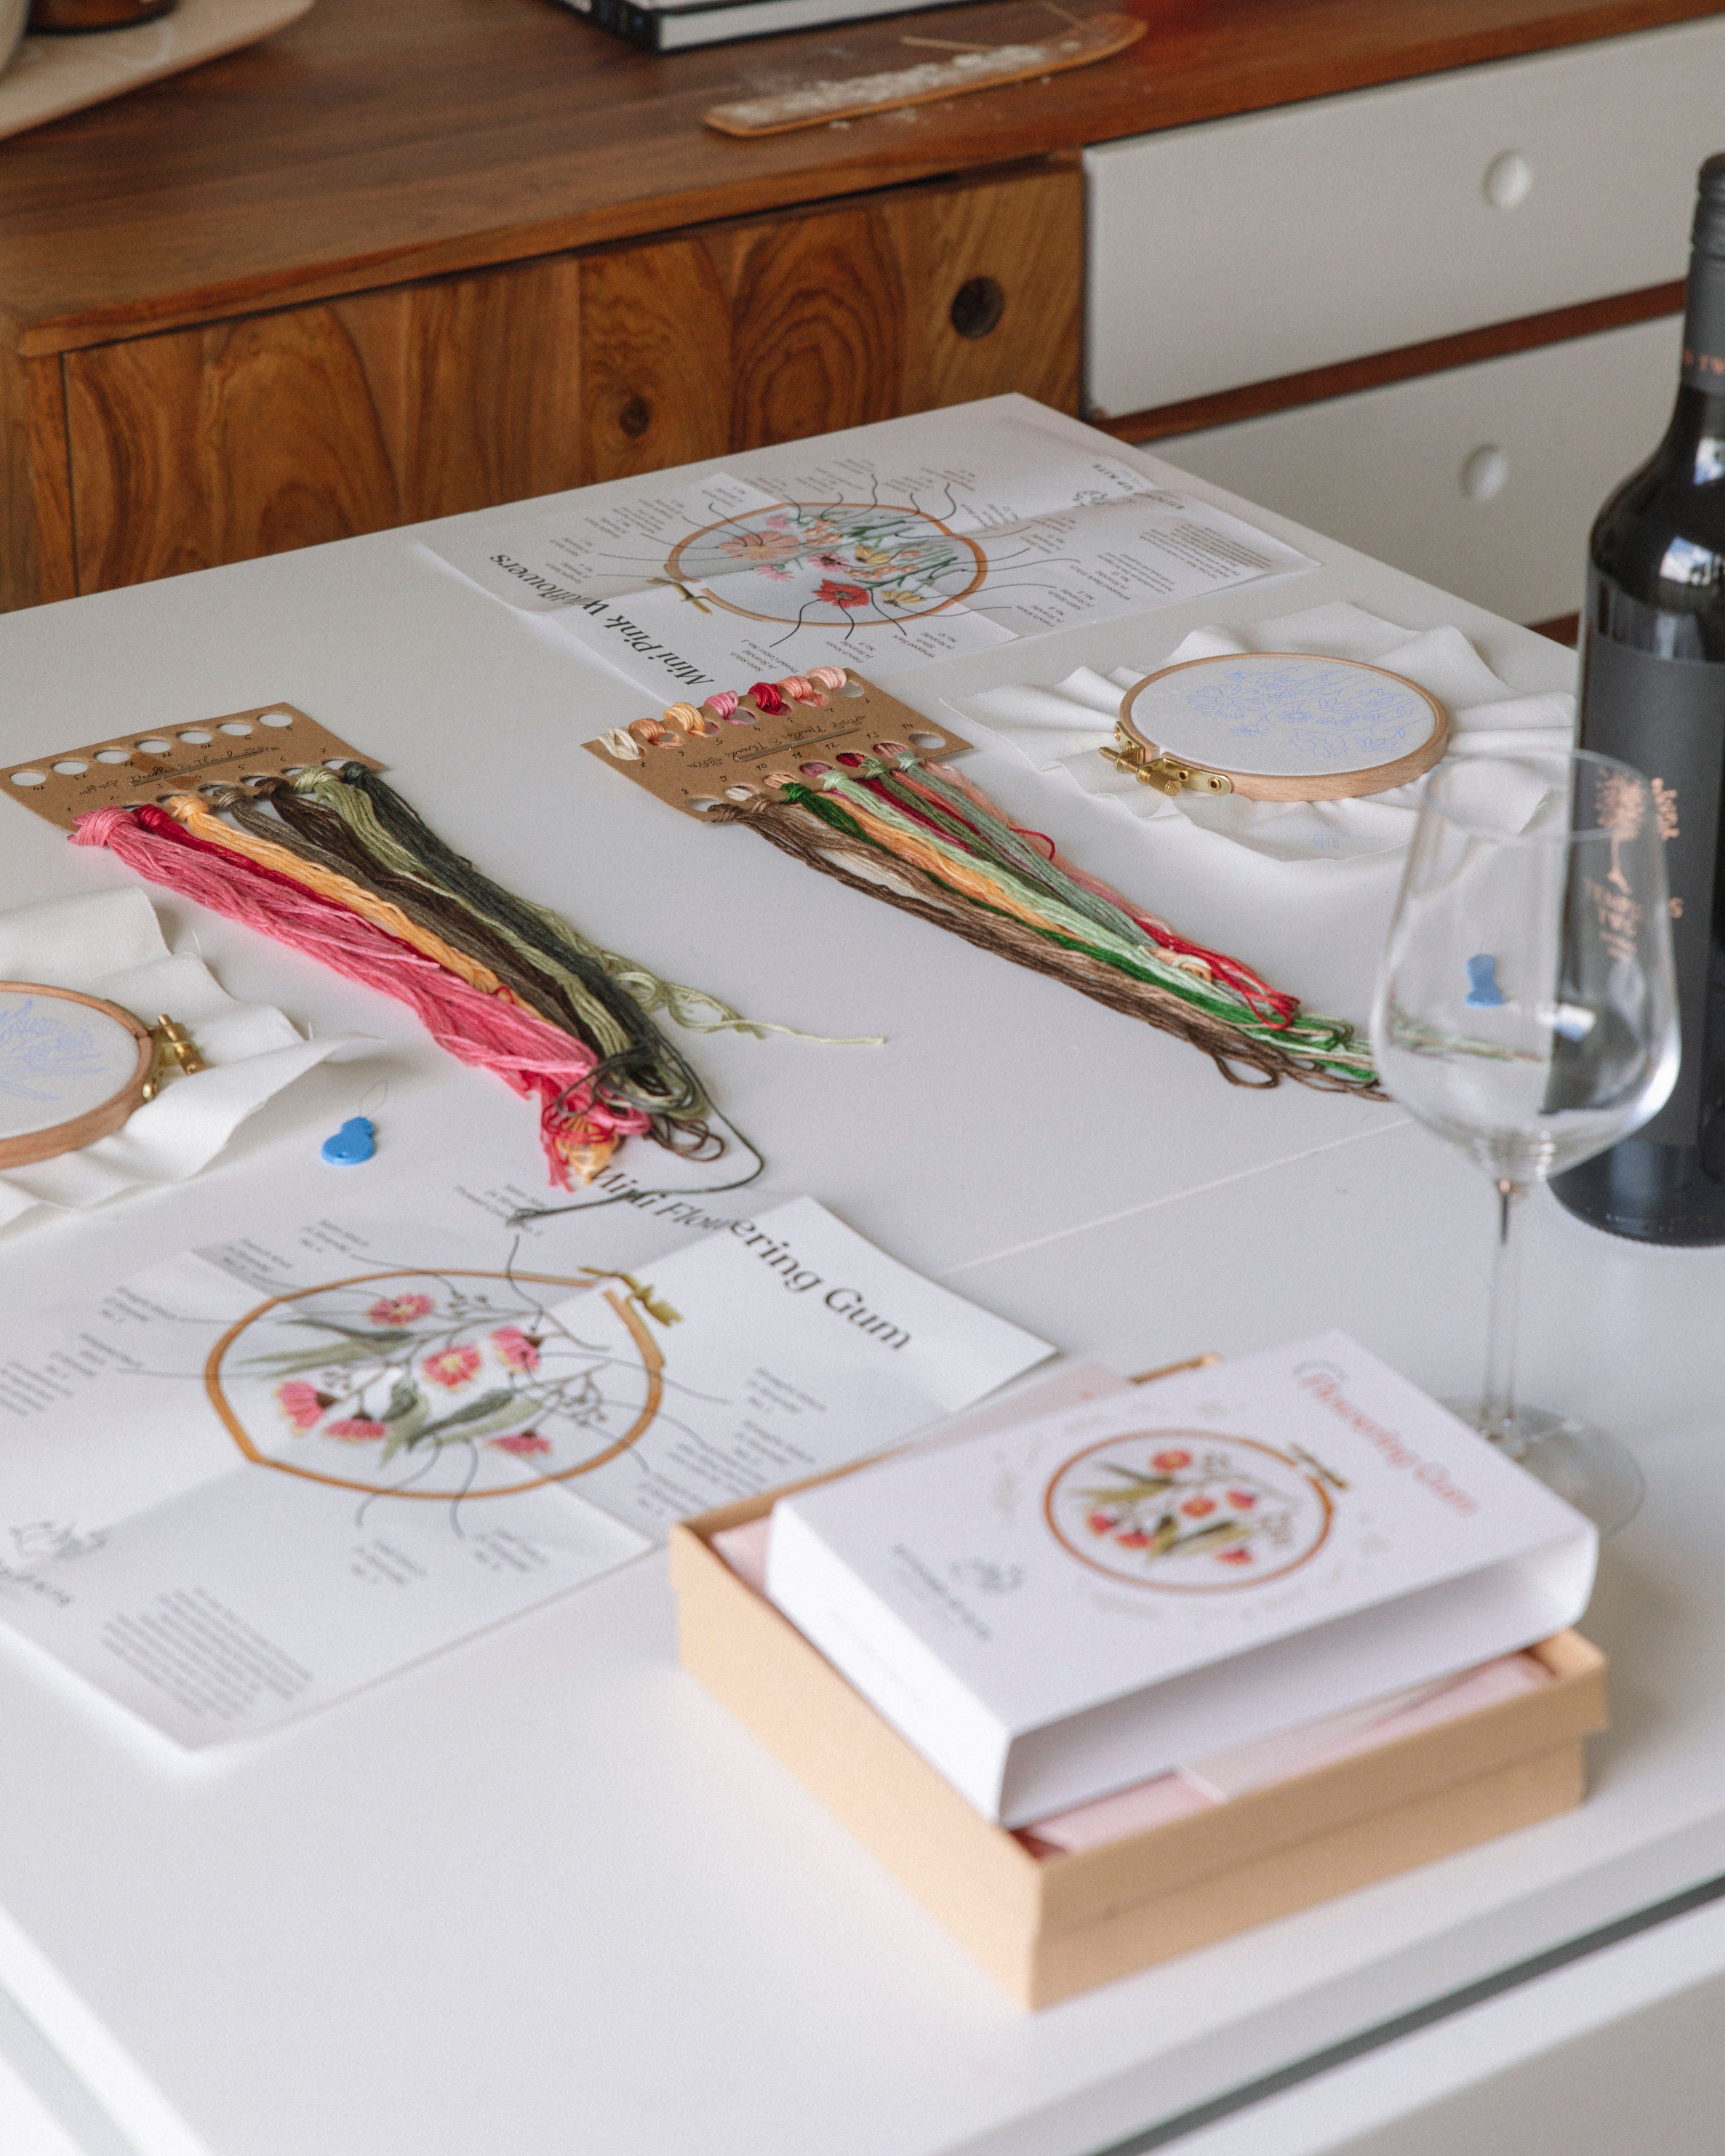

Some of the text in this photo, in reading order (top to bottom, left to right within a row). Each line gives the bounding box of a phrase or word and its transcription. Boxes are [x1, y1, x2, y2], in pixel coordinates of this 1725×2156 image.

[490, 553, 715, 685] Mini Pink Wildflowers
[893, 634, 935, 659] Whipped Back
[916, 638, 936, 649] Stitch
[758, 649, 779, 661] Colour
[825, 641, 864, 664] French Knots
[730, 652, 764, 672] Satin Stitch
[776, 660, 799, 674] Thread
[780, 726, 827, 741] Needles
[724, 741, 768, 758] Threads
[824, 741, 841, 750] 12
[755, 762, 767, 771] 10
[655, 1200, 825, 1292] Flowering
[825, 1286, 913, 1351] Gum
